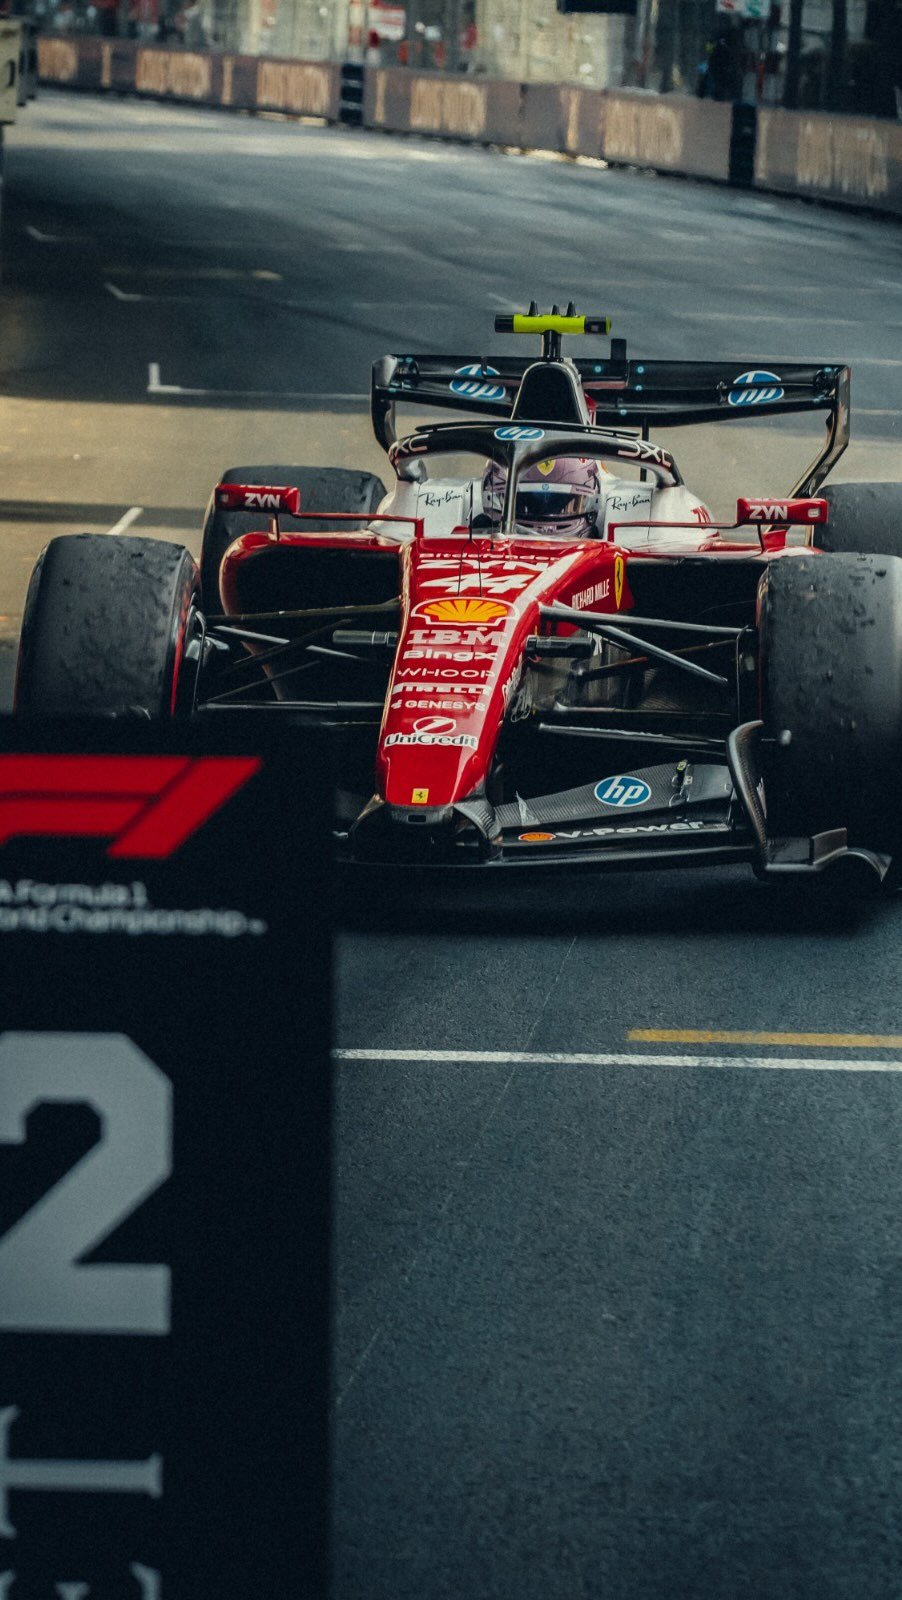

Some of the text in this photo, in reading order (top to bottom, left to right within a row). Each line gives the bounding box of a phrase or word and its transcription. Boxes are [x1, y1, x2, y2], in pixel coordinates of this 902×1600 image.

[245, 492, 281, 508] ZYN
[418, 491, 463, 507] Ray-Ban
[606, 495, 650, 511] Ray-Ban
[748, 505, 788, 520] ZYN
[416, 559, 550, 572] ZYN
[419, 572, 536, 594] 44
[407, 629, 507, 648] IBM
[397, 668, 496, 679] WHOOP
[404, 700, 487, 712] GENESYS
[385, 733, 477, 748] UniCredit
[602, 776, 646, 806] hp
[0, 904, 54, 932] orld
[0, 1030, 174, 1337] 2
